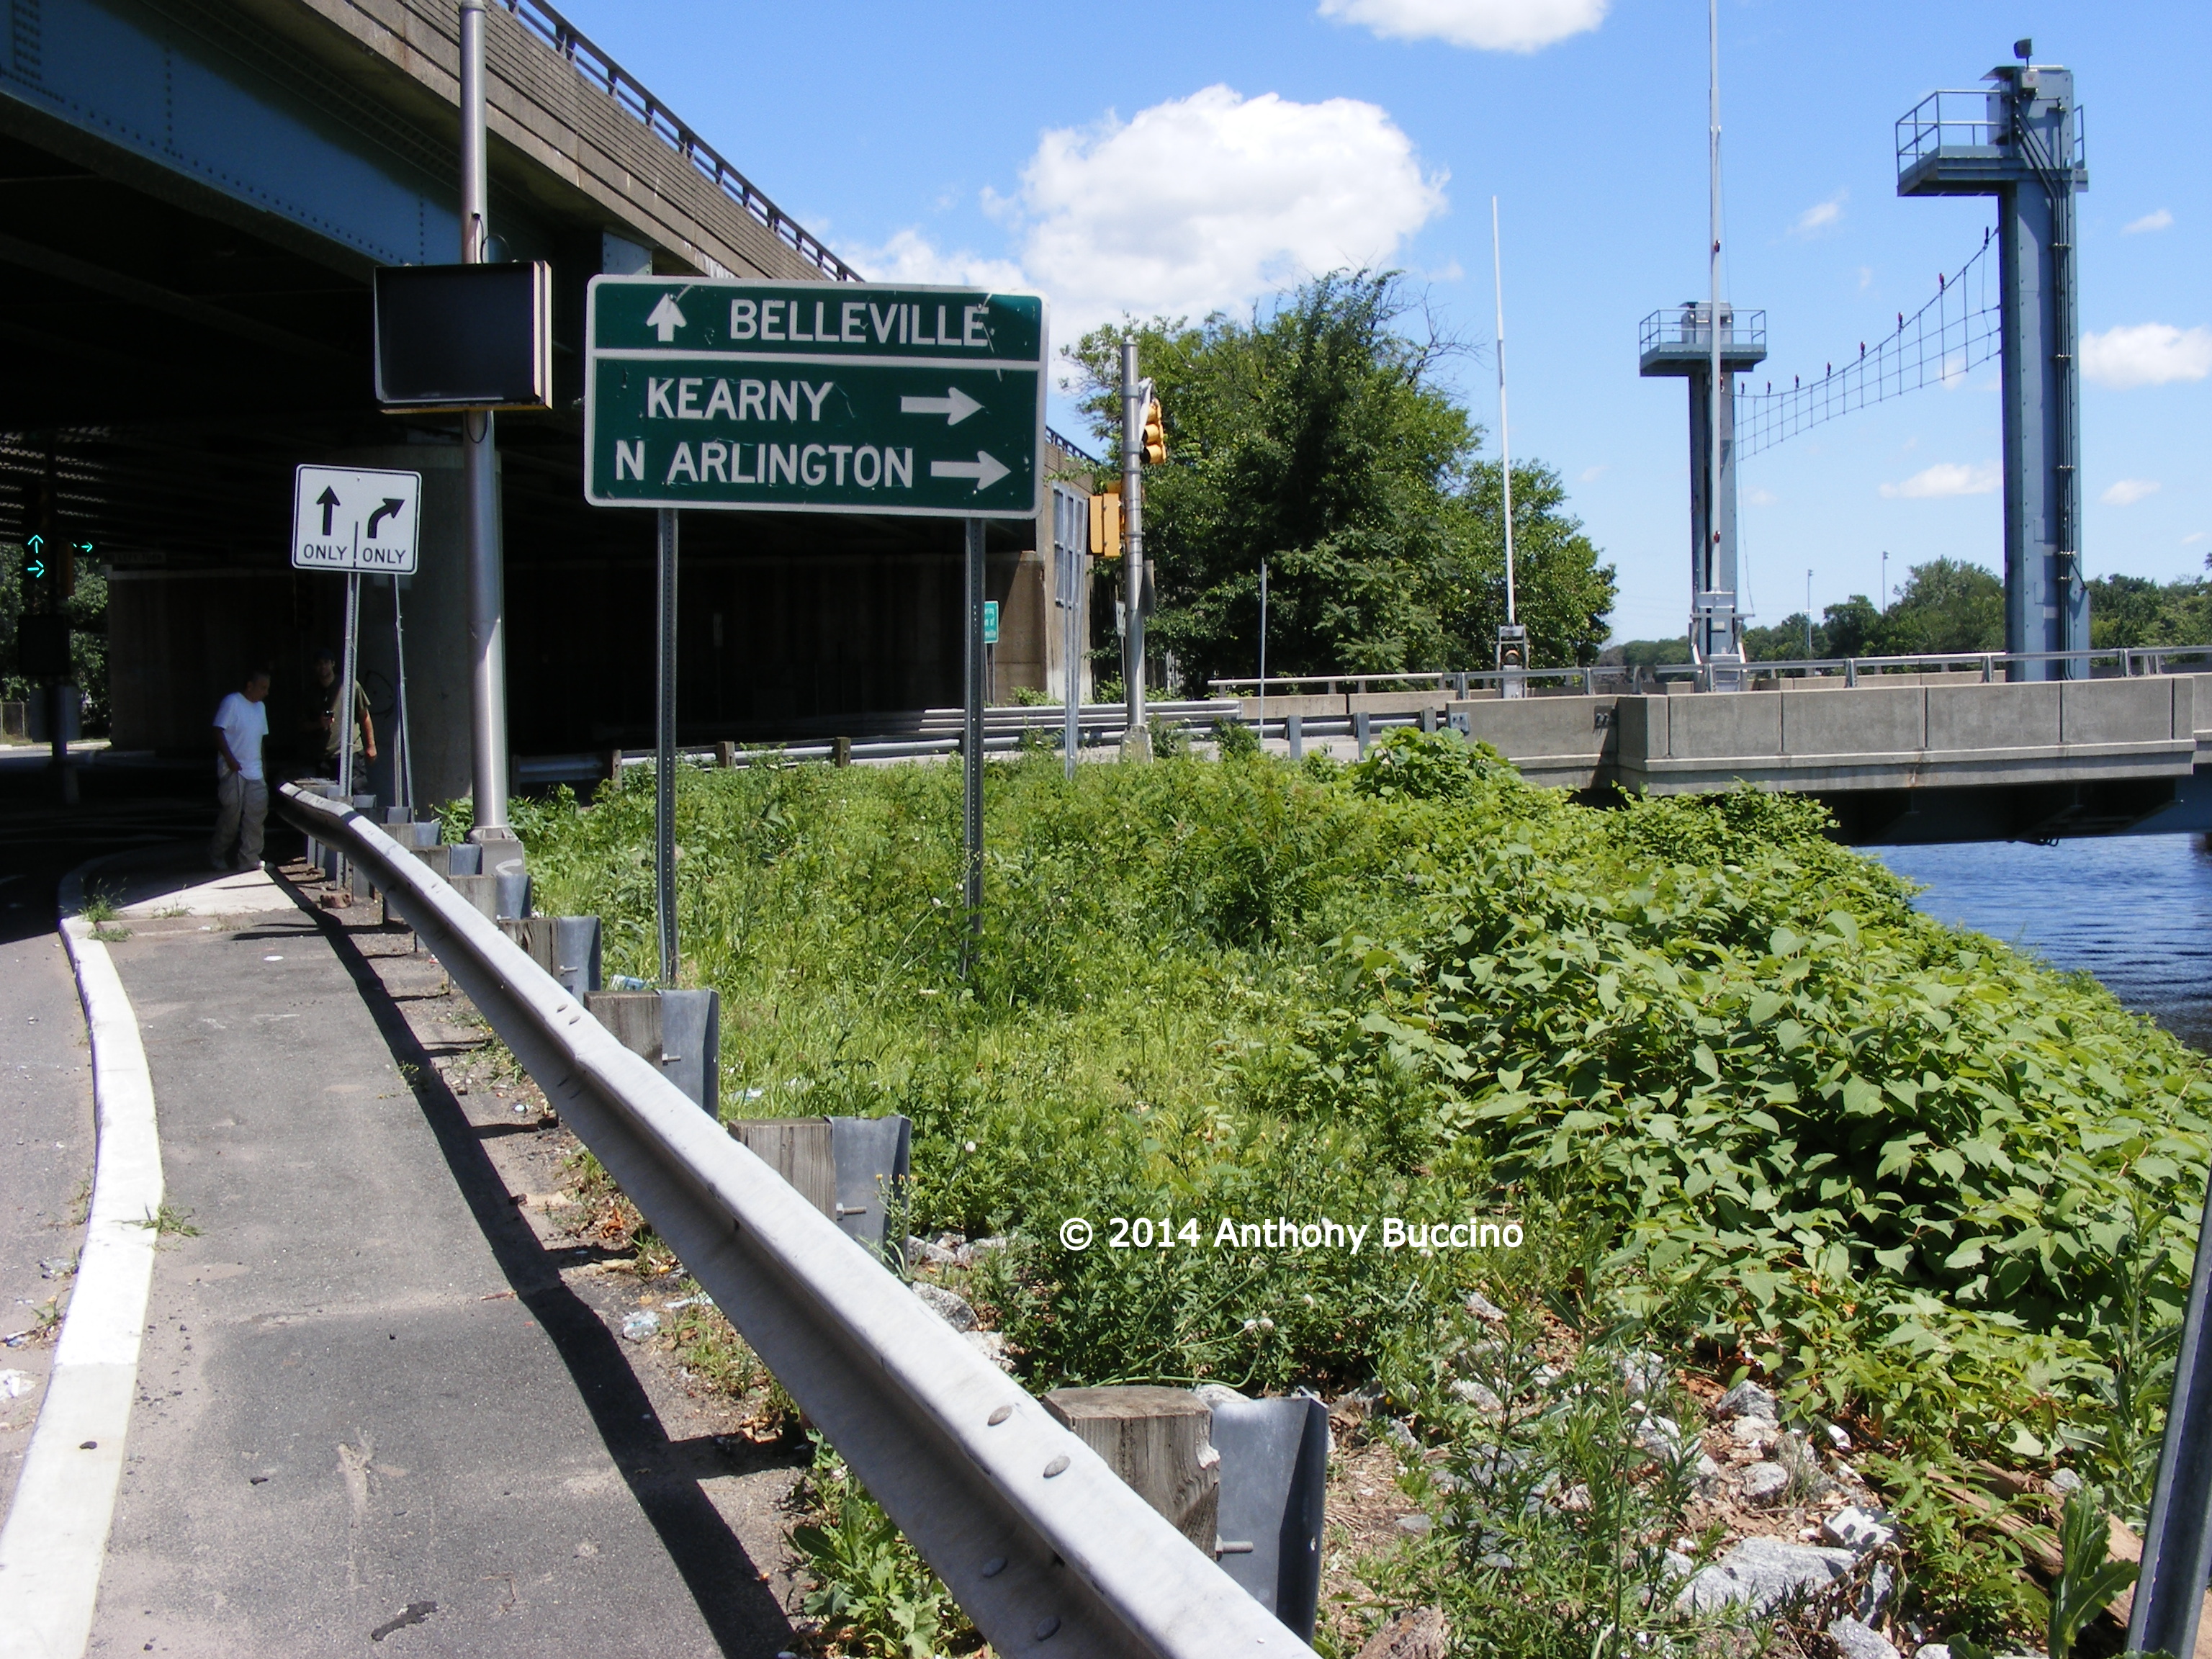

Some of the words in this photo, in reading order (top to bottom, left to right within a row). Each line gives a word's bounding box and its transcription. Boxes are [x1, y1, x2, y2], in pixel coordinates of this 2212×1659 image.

[729, 298, 989, 346] BELLEVILLE
[647, 377, 834, 421] KEARNY
[616, 440, 644, 480] N
[667, 442, 913, 488] ARLINGTON
[303, 544, 348, 561] ONLY
[362, 547, 406, 564] ONLY
